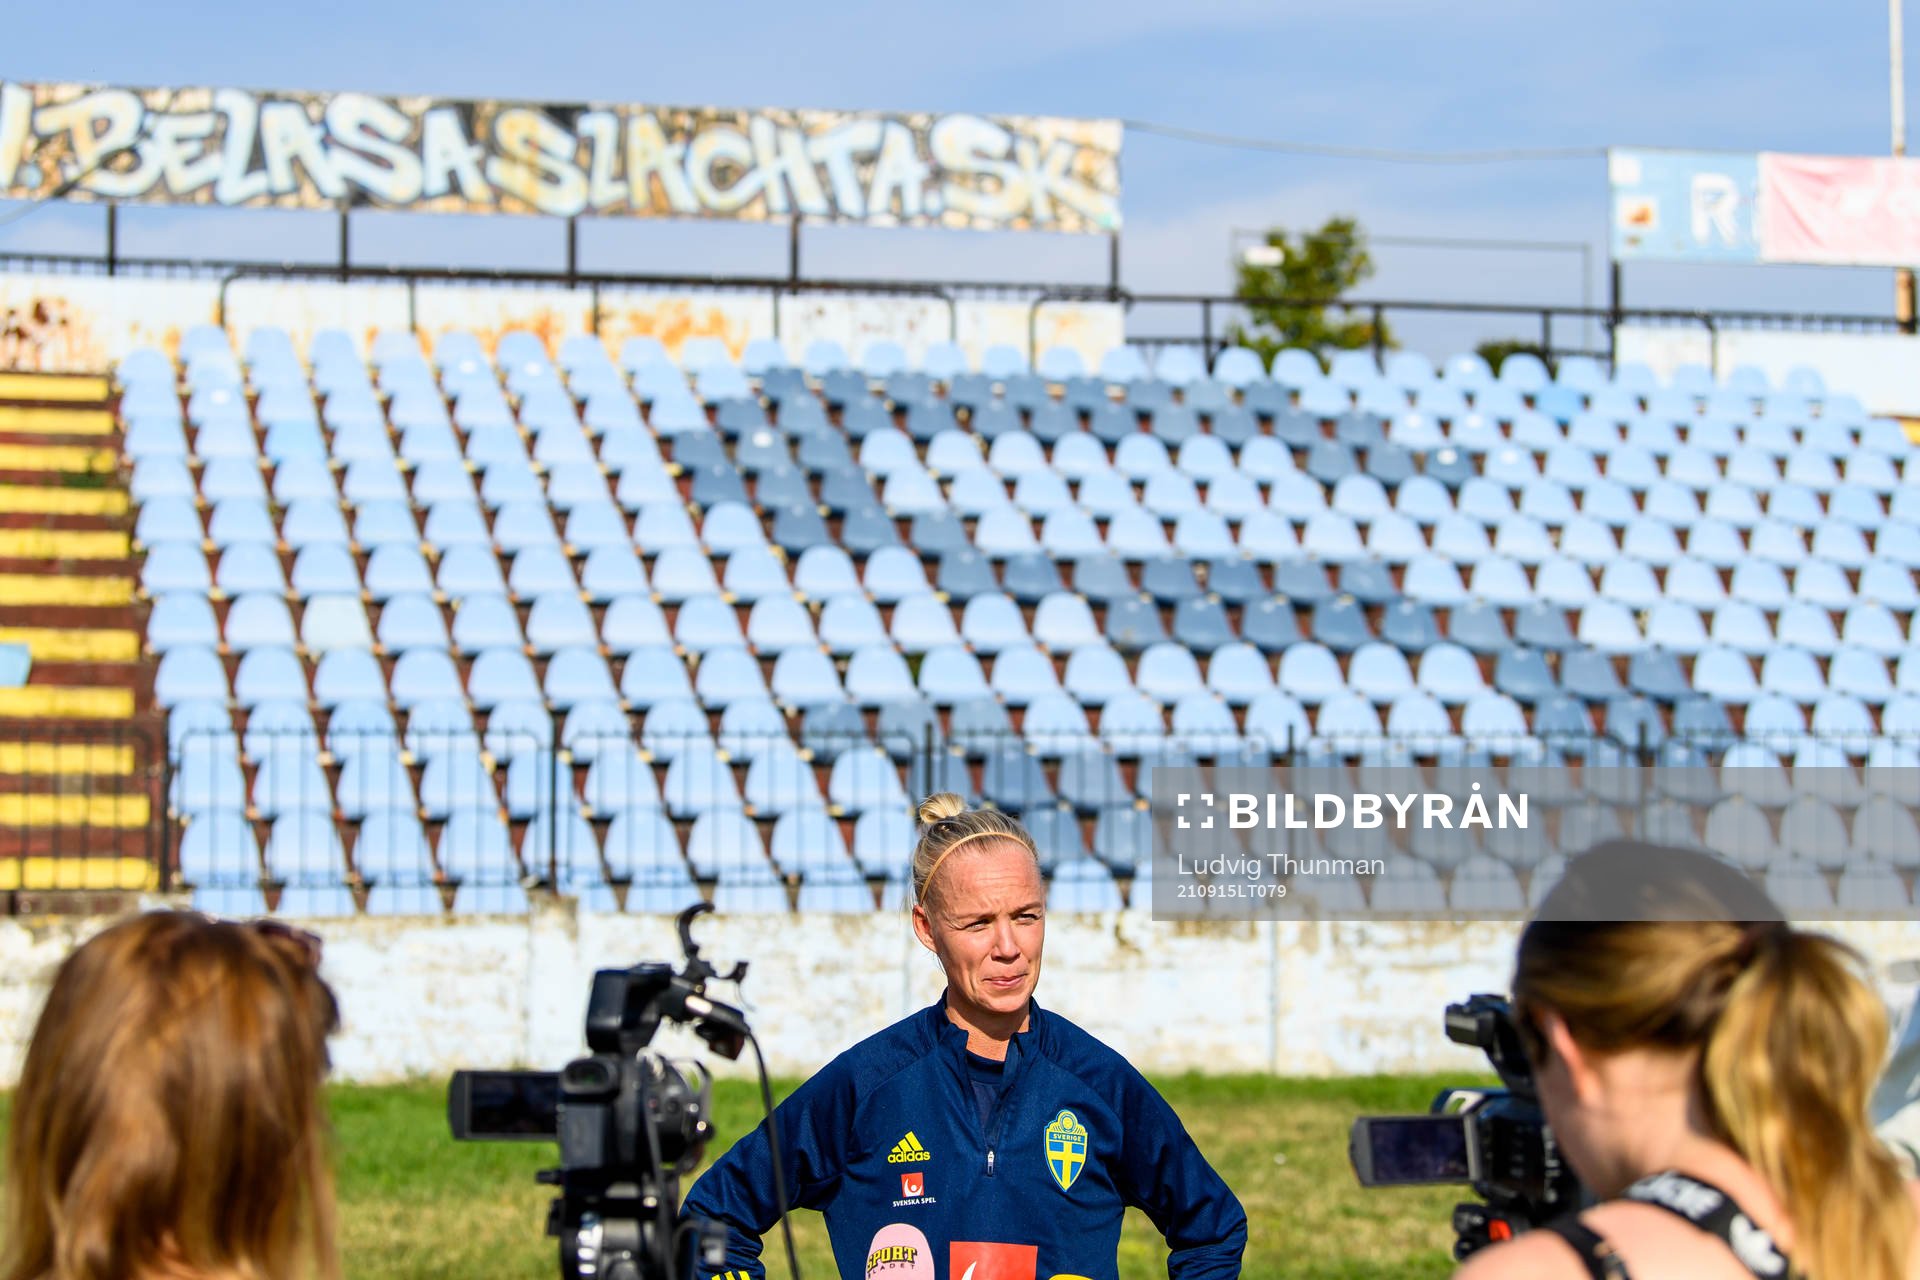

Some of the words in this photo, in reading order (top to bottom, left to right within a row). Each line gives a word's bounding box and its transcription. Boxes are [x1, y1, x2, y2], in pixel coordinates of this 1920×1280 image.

[1052, 1133, 1082, 1142] SVERIGE
[887, 1151, 931, 1163] adidas
[892, 1199, 920, 1207] SVENSKA
[867, 1245, 917, 1273] SPORT
